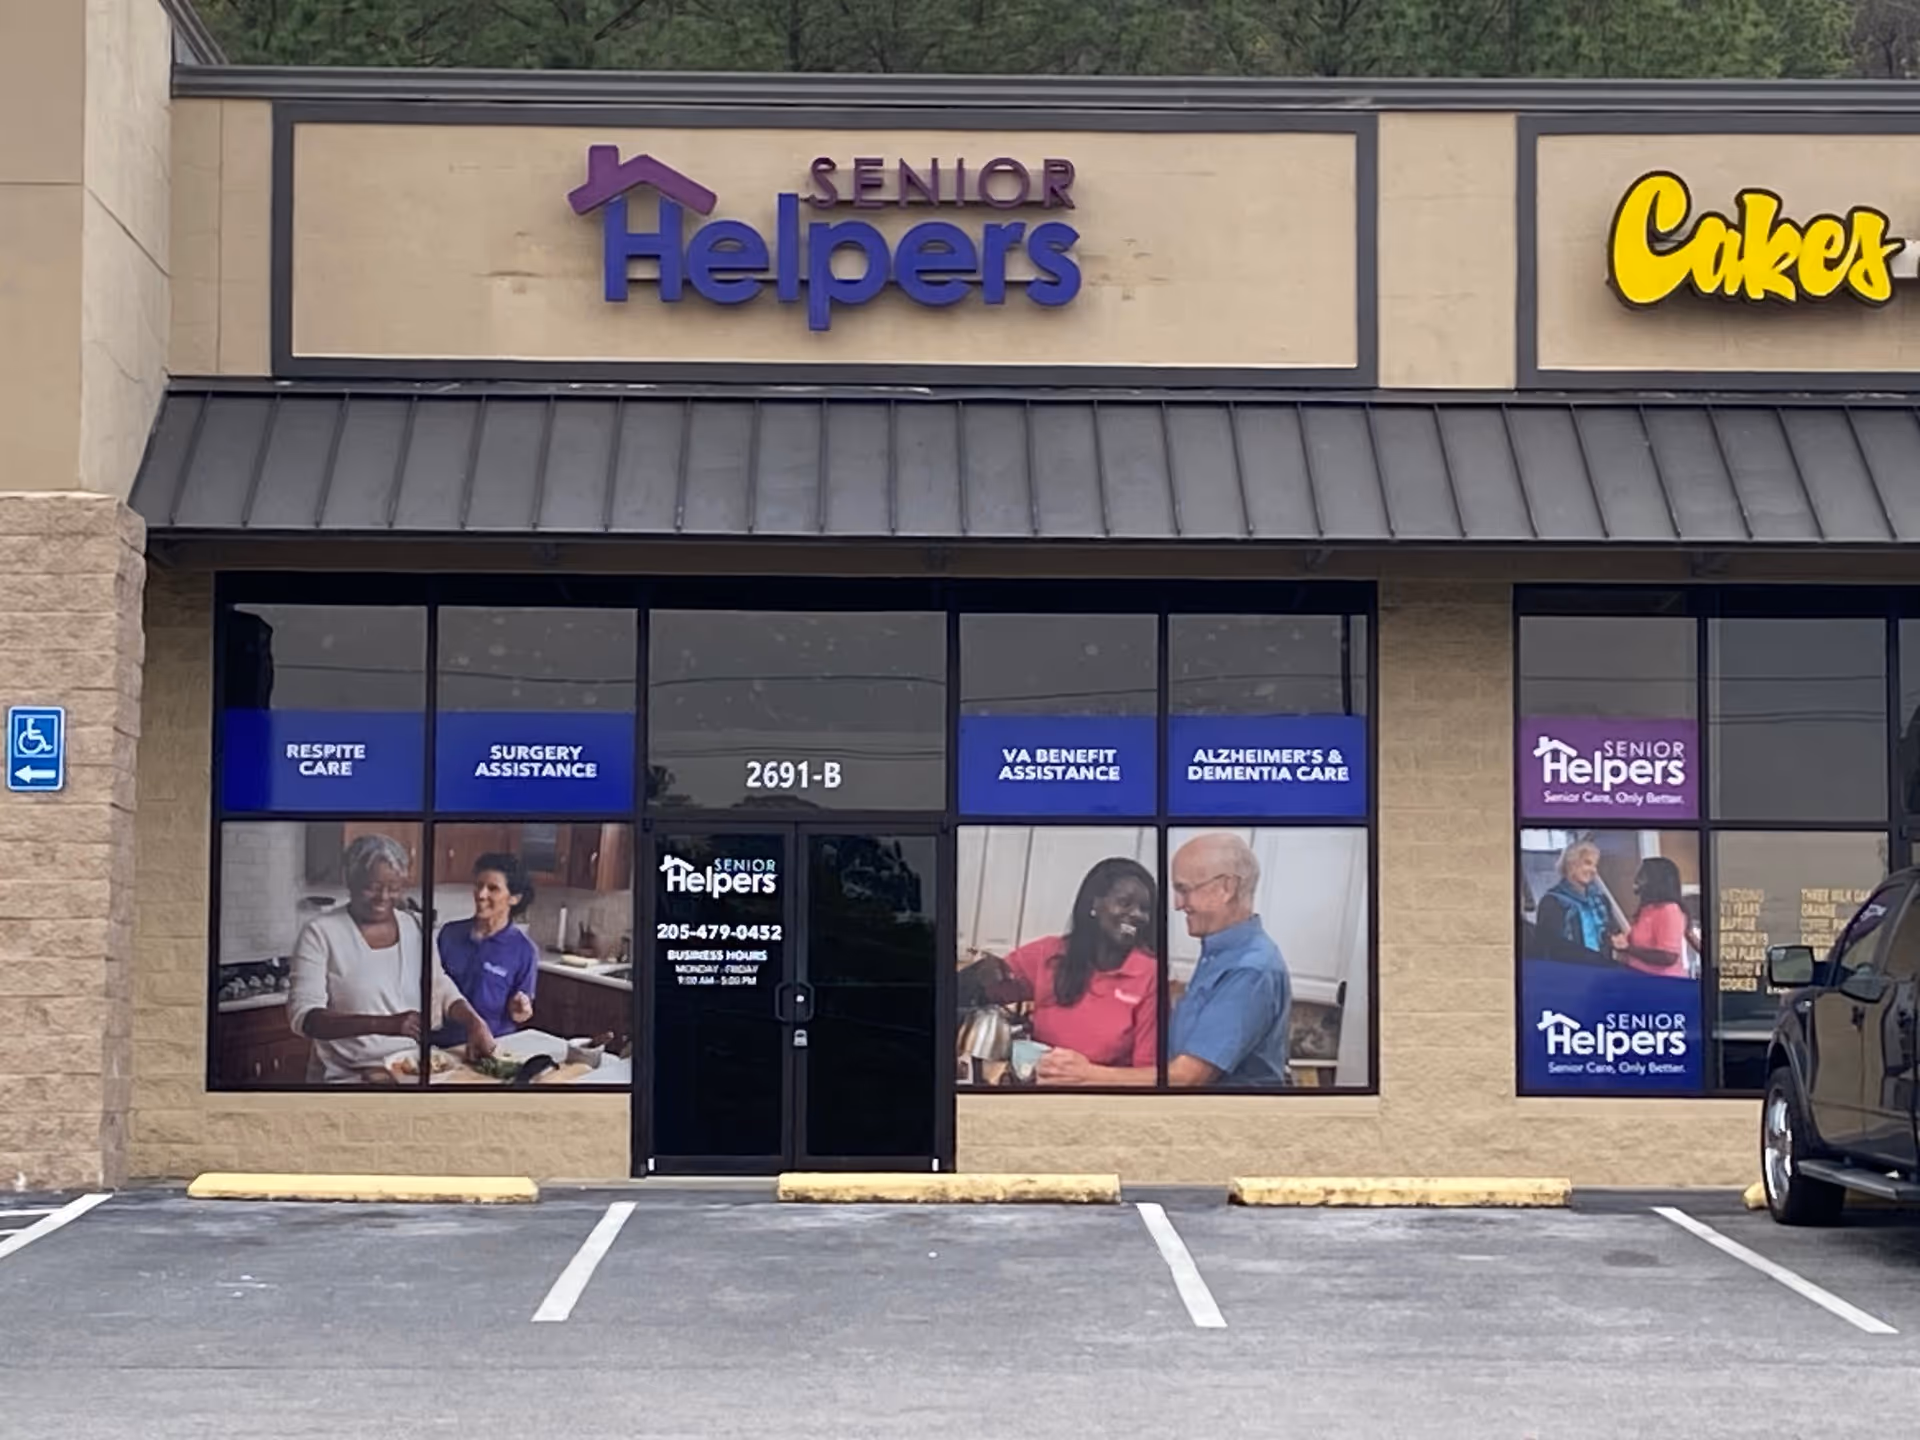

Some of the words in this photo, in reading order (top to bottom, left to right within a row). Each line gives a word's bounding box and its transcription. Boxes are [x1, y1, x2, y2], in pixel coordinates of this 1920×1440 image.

[809, 156, 1076, 209] SENIOR
[1610, 172, 1904, 306] Cakes
[604, 192, 1082, 332] Helpers
[286, 743, 366, 759] RESPITE
[490, 744, 583, 761] SURGERY
[1002, 748, 1032, 764] VA
[1036, 748, 1117, 764] BENEFIT
[1193, 748, 1323, 764] ALZHEIMER'S
[1328, 749, 1344, 764] &
[1603, 740, 1685, 758] SENIOR
[299, 760, 353, 776] CARE
[475, 762, 598, 778] ASSISTANCE
[746, 761, 842, 788] 2691-B
[998, 765, 1121, 781] ASSISTANCE
[1187, 765, 1293, 781] DEMENTIA
[1296, 765, 1350, 781] CARE
[1543, 750, 1686, 792] Helpers
[1543, 790, 1580, 803] Senior
[1582, 791, 1614, 804] Care,
[1615, 791, 1644, 807] Only
[1646, 791, 1685, 804] Better.
[714, 858, 776, 872] SENIOR
[666, 865, 777, 898] Helpers
[657, 923, 782, 940] 205-479-0452
[667, 950, 723, 961] BUSINESS
[725, 950, 768, 961] HOURS
[1606, 1012, 1686, 1030] SENIOR
[1547, 1023, 1687, 1063] Helpers
[1548, 1061, 1584, 1074] Senior
[1586, 1061, 1617, 1074] Care,
[1618, 1061, 1646, 1076] Only
[1648, 1061, 1686, 1074] Better.
